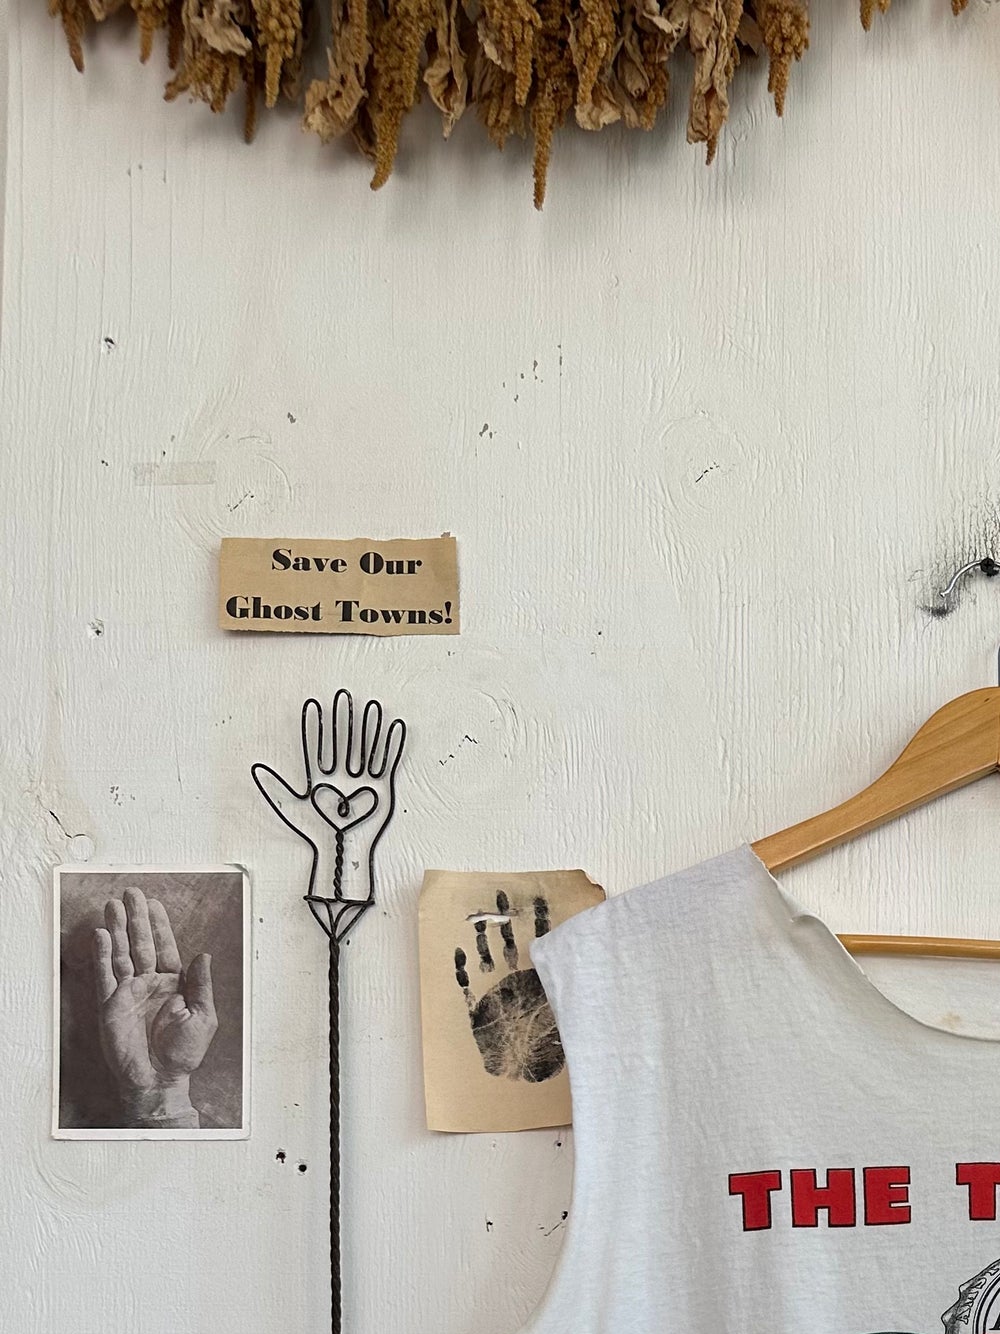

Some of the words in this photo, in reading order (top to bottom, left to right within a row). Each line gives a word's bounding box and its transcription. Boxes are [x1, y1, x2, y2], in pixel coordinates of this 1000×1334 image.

[272, 548, 348, 573] Save
[359, 551, 423, 575] Our
[226, 595, 323, 622] Ghost
[335, 600, 453, 625] Towns!
[728, 1166, 911, 1232] THE
